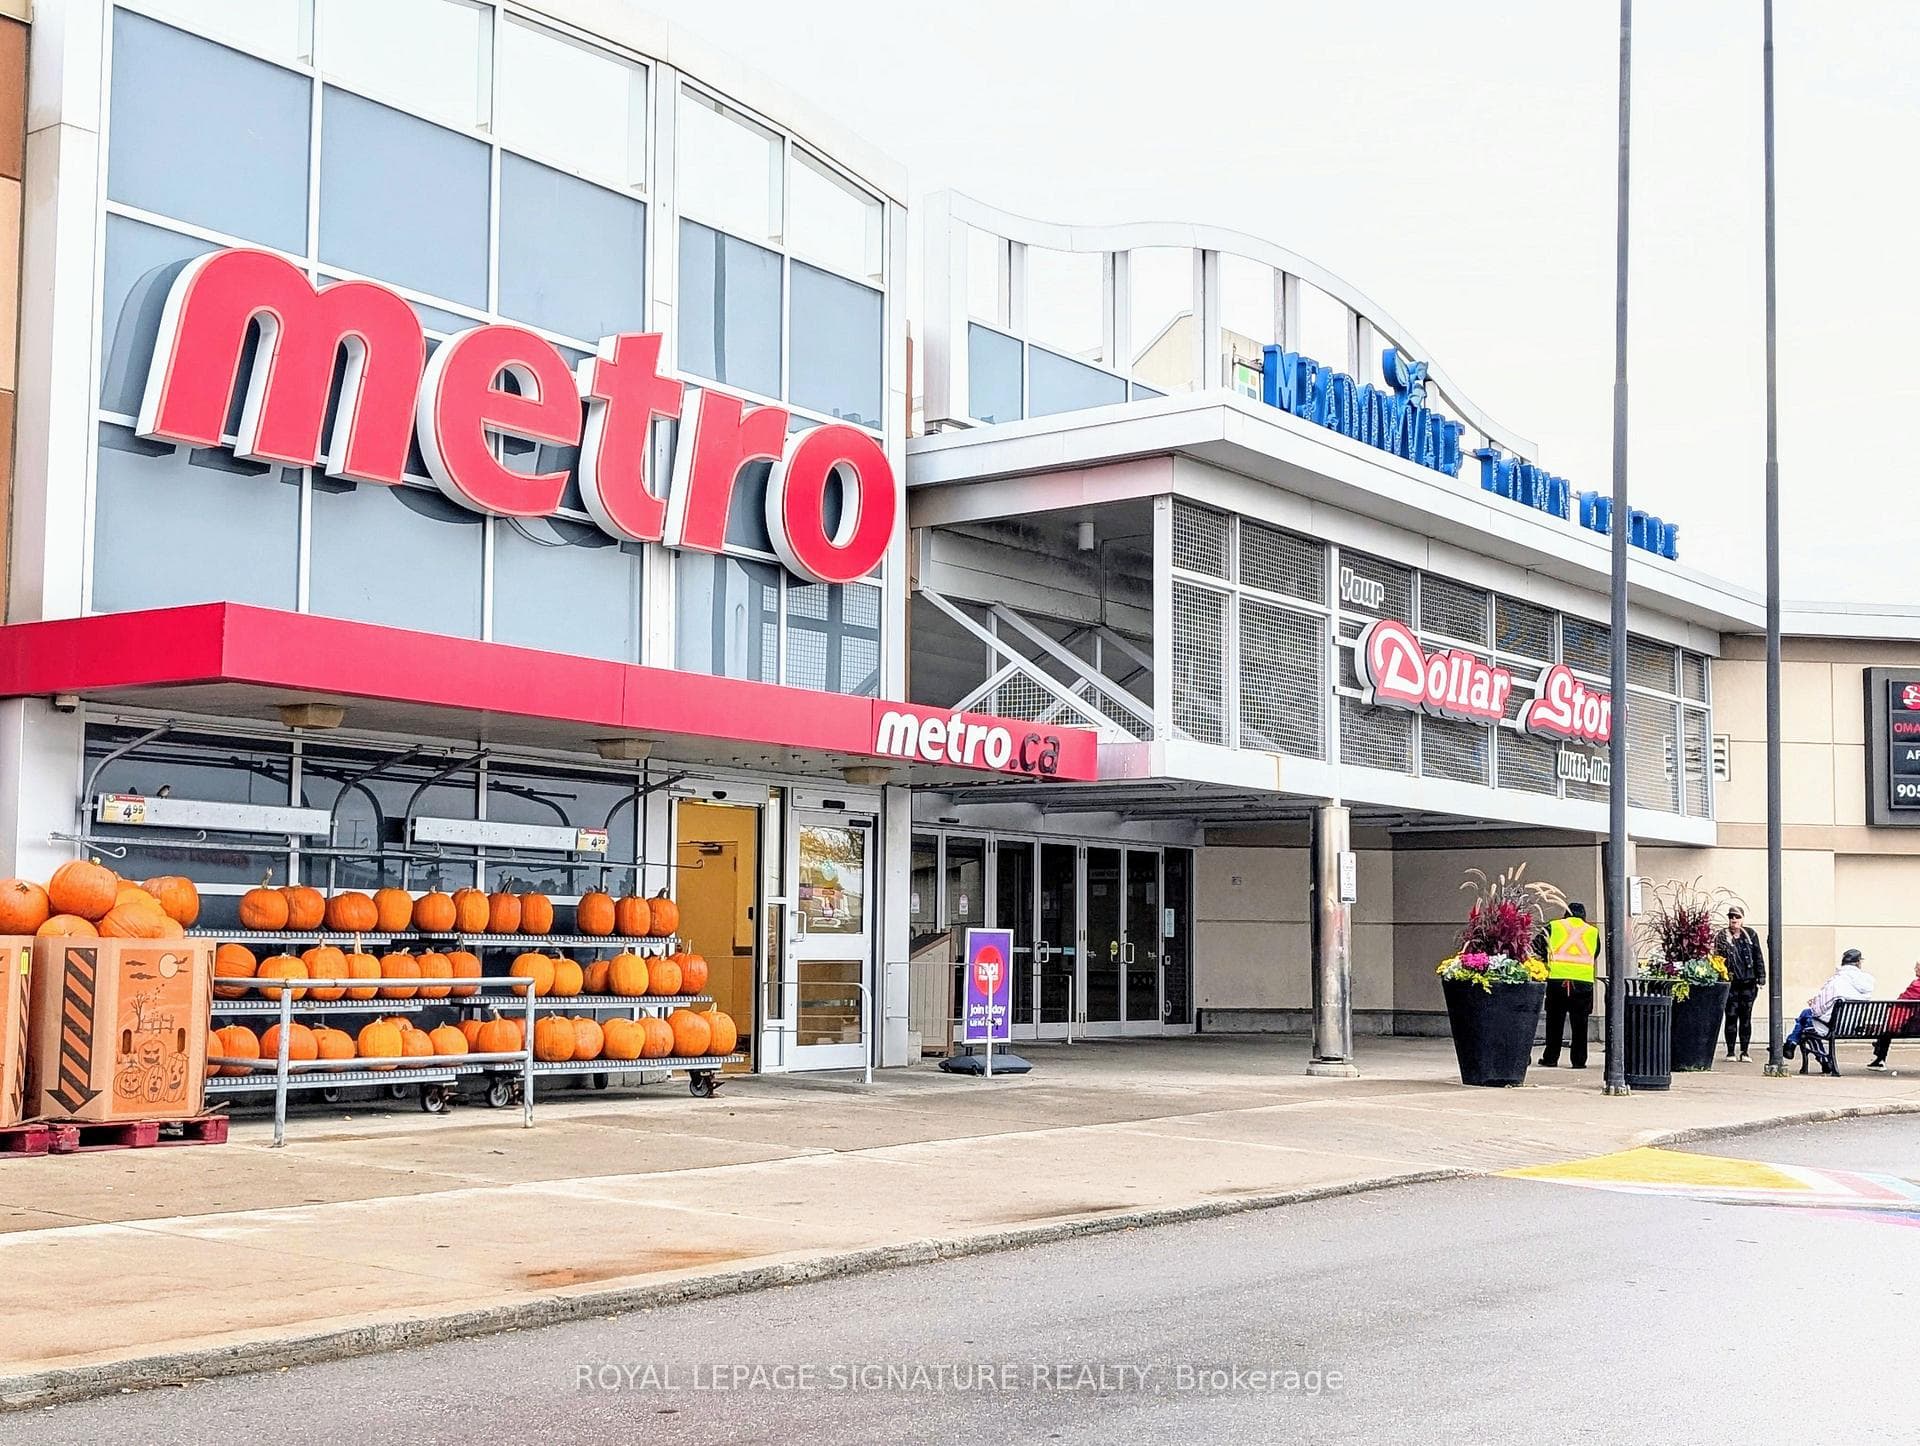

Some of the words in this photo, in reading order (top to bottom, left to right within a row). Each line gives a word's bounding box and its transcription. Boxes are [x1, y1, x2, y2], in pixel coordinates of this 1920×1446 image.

[136, 247, 897, 584] metro
[1580, 490, 1680, 561] CETRE
[1340, 566, 1385, 609] Your
[1371, 624, 1512, 716] Dollar
[1532, 671, 1612, 737] Stor
[875, 710, 1061, 774] metro.ca
[1590, 756, 1611, 785] Mo
[985, 1004, 1006, 1017] tday
